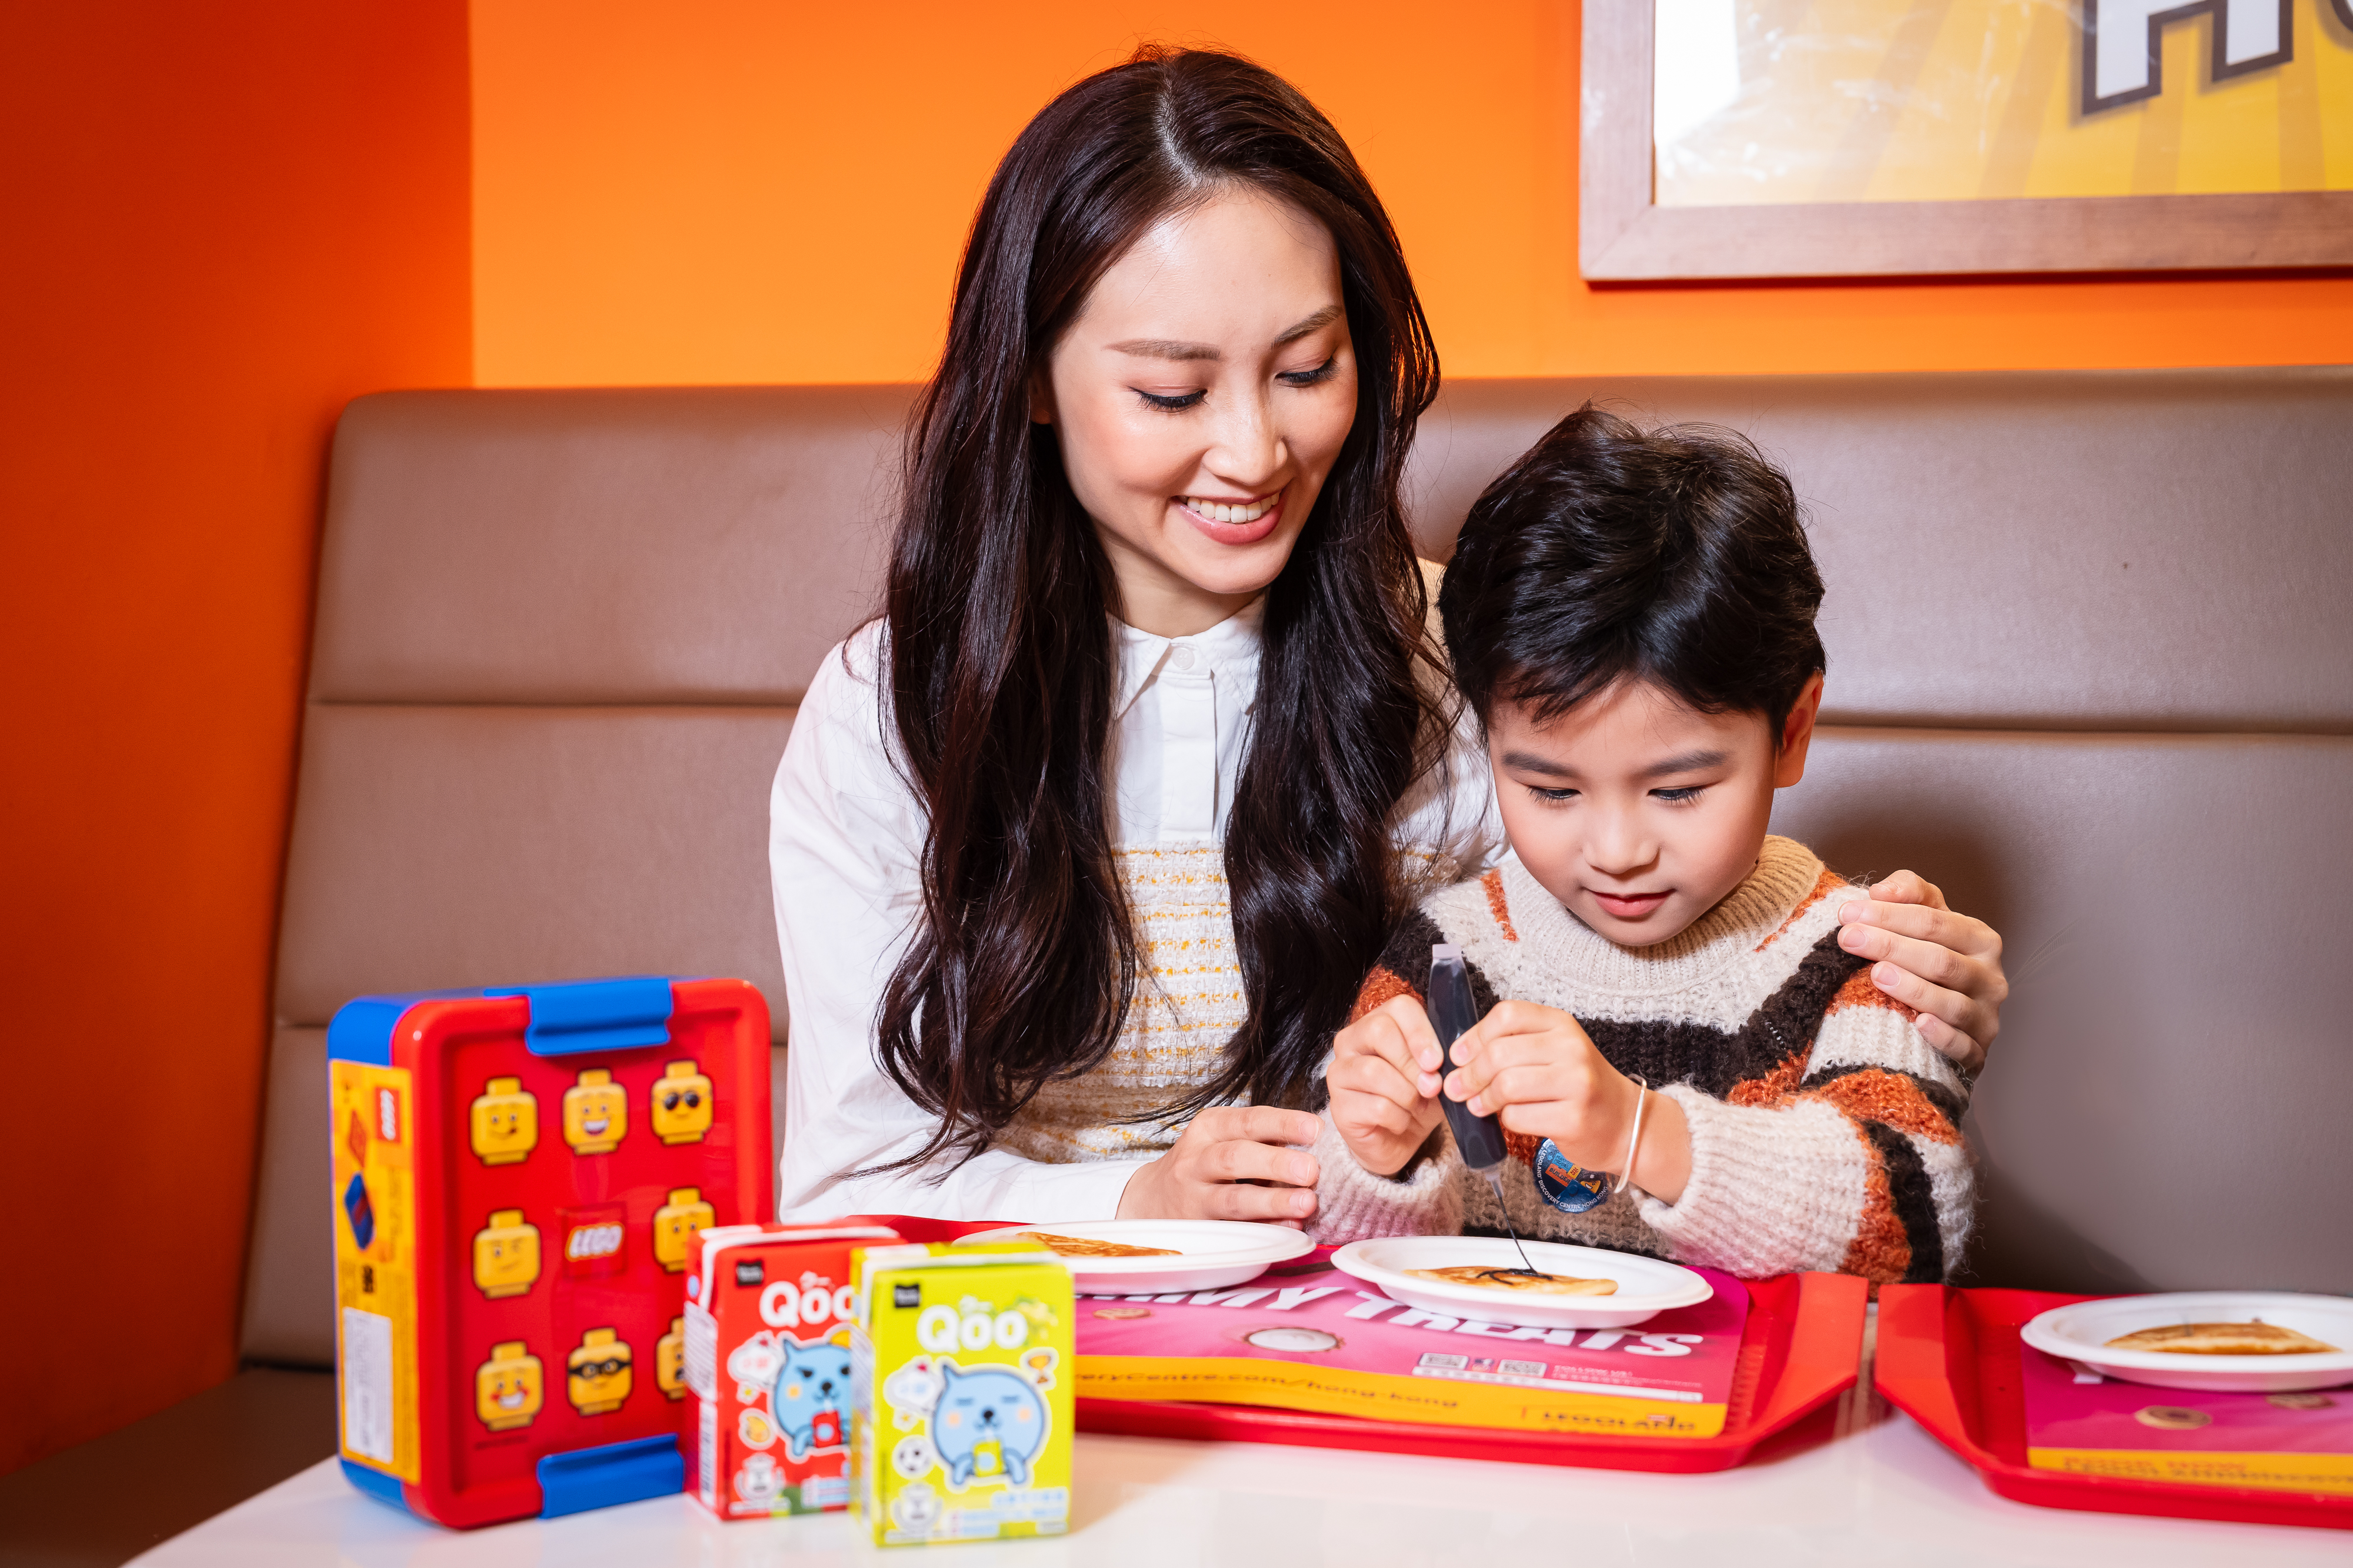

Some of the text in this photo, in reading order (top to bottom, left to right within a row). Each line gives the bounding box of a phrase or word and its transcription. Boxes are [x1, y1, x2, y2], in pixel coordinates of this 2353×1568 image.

[1537, 1150, 1547, 1178] LEGOLAND
[1549, 1167, 1571, 1183] BUILDER
[1538, 1180, 1559, 1204] DISCOVERY
[1582, 1198, 1598, 1207] HONG
[1597, 1186, 1608, 1200] KONG
[568, 1225, 623, 1258] LEGO
[759, 1280, 852, 1328] Qoo
[916, 1305, 1028, 1354] Qoo
